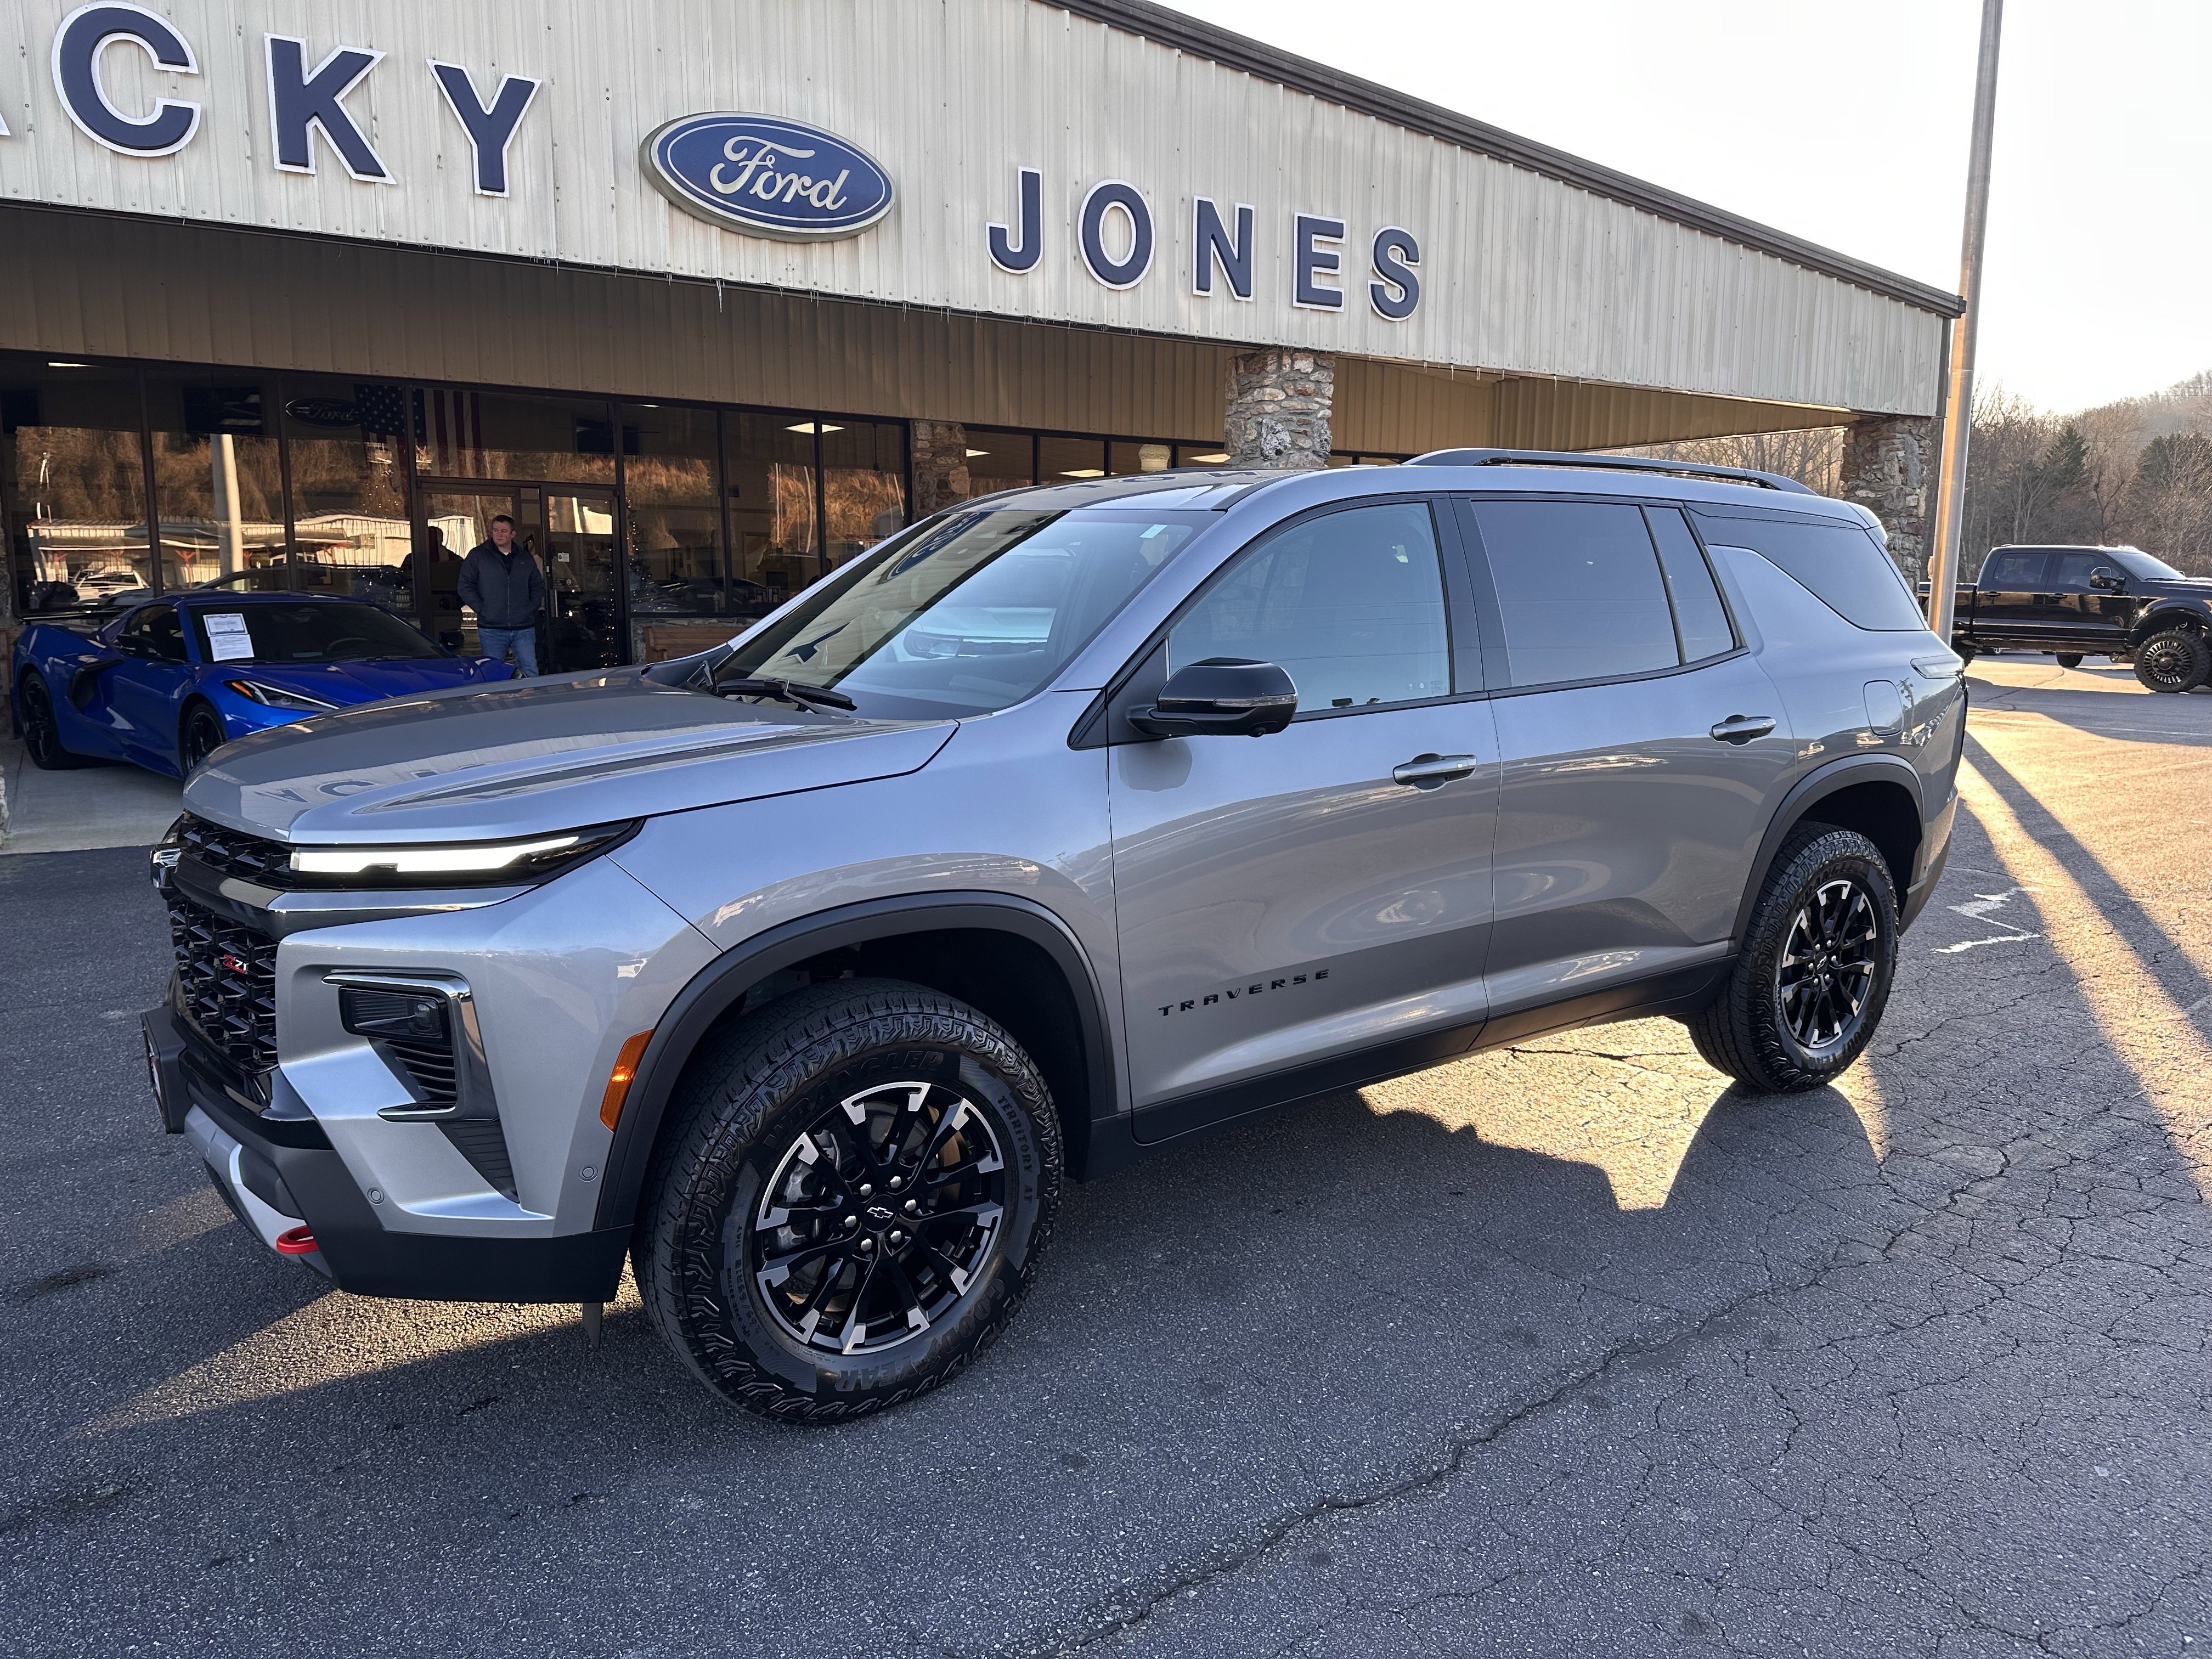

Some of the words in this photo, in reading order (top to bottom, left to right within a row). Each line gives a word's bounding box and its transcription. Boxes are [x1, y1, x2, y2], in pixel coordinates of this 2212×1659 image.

[0, 1, 542, 198] CKY
[985, 166, 1421, 321] JONES
[709, 136, 850, 210] Ford
[223, 953, 249, 974] Z71
[1158, 969, 1329, 1016] TRAVERSE
[763, 1050, 944, 1149] WRANGLER
[997, 1096, 1032, 1173] TERRITORY
[1024, 1184, 1034, 1204] AT
[834, 1278, 1005, 1392] GOODYEAR
